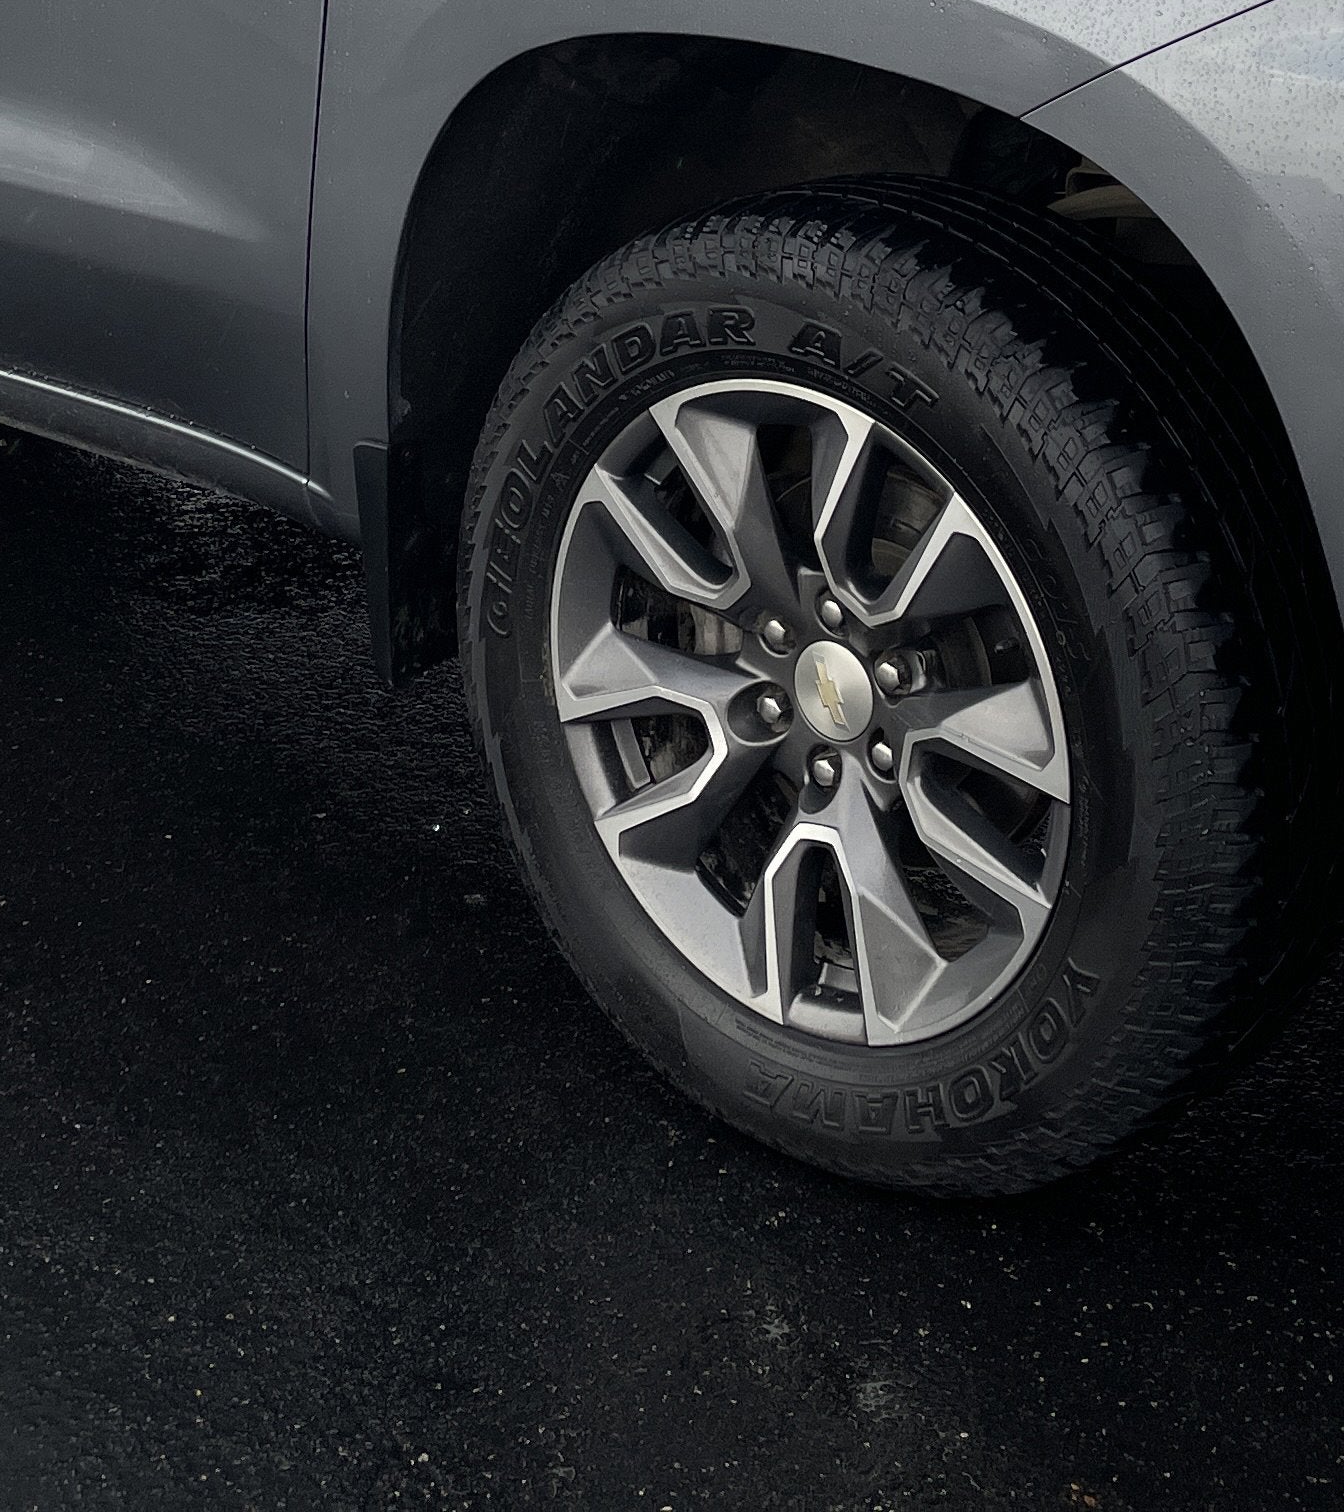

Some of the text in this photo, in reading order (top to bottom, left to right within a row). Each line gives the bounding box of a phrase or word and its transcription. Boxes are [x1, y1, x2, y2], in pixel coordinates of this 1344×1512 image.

[486, 305, 757, 638] GEOLANDAR
[788, 319, 941, 412] A/T
[742, 956, 1102, 1136] YOKOHAMA
